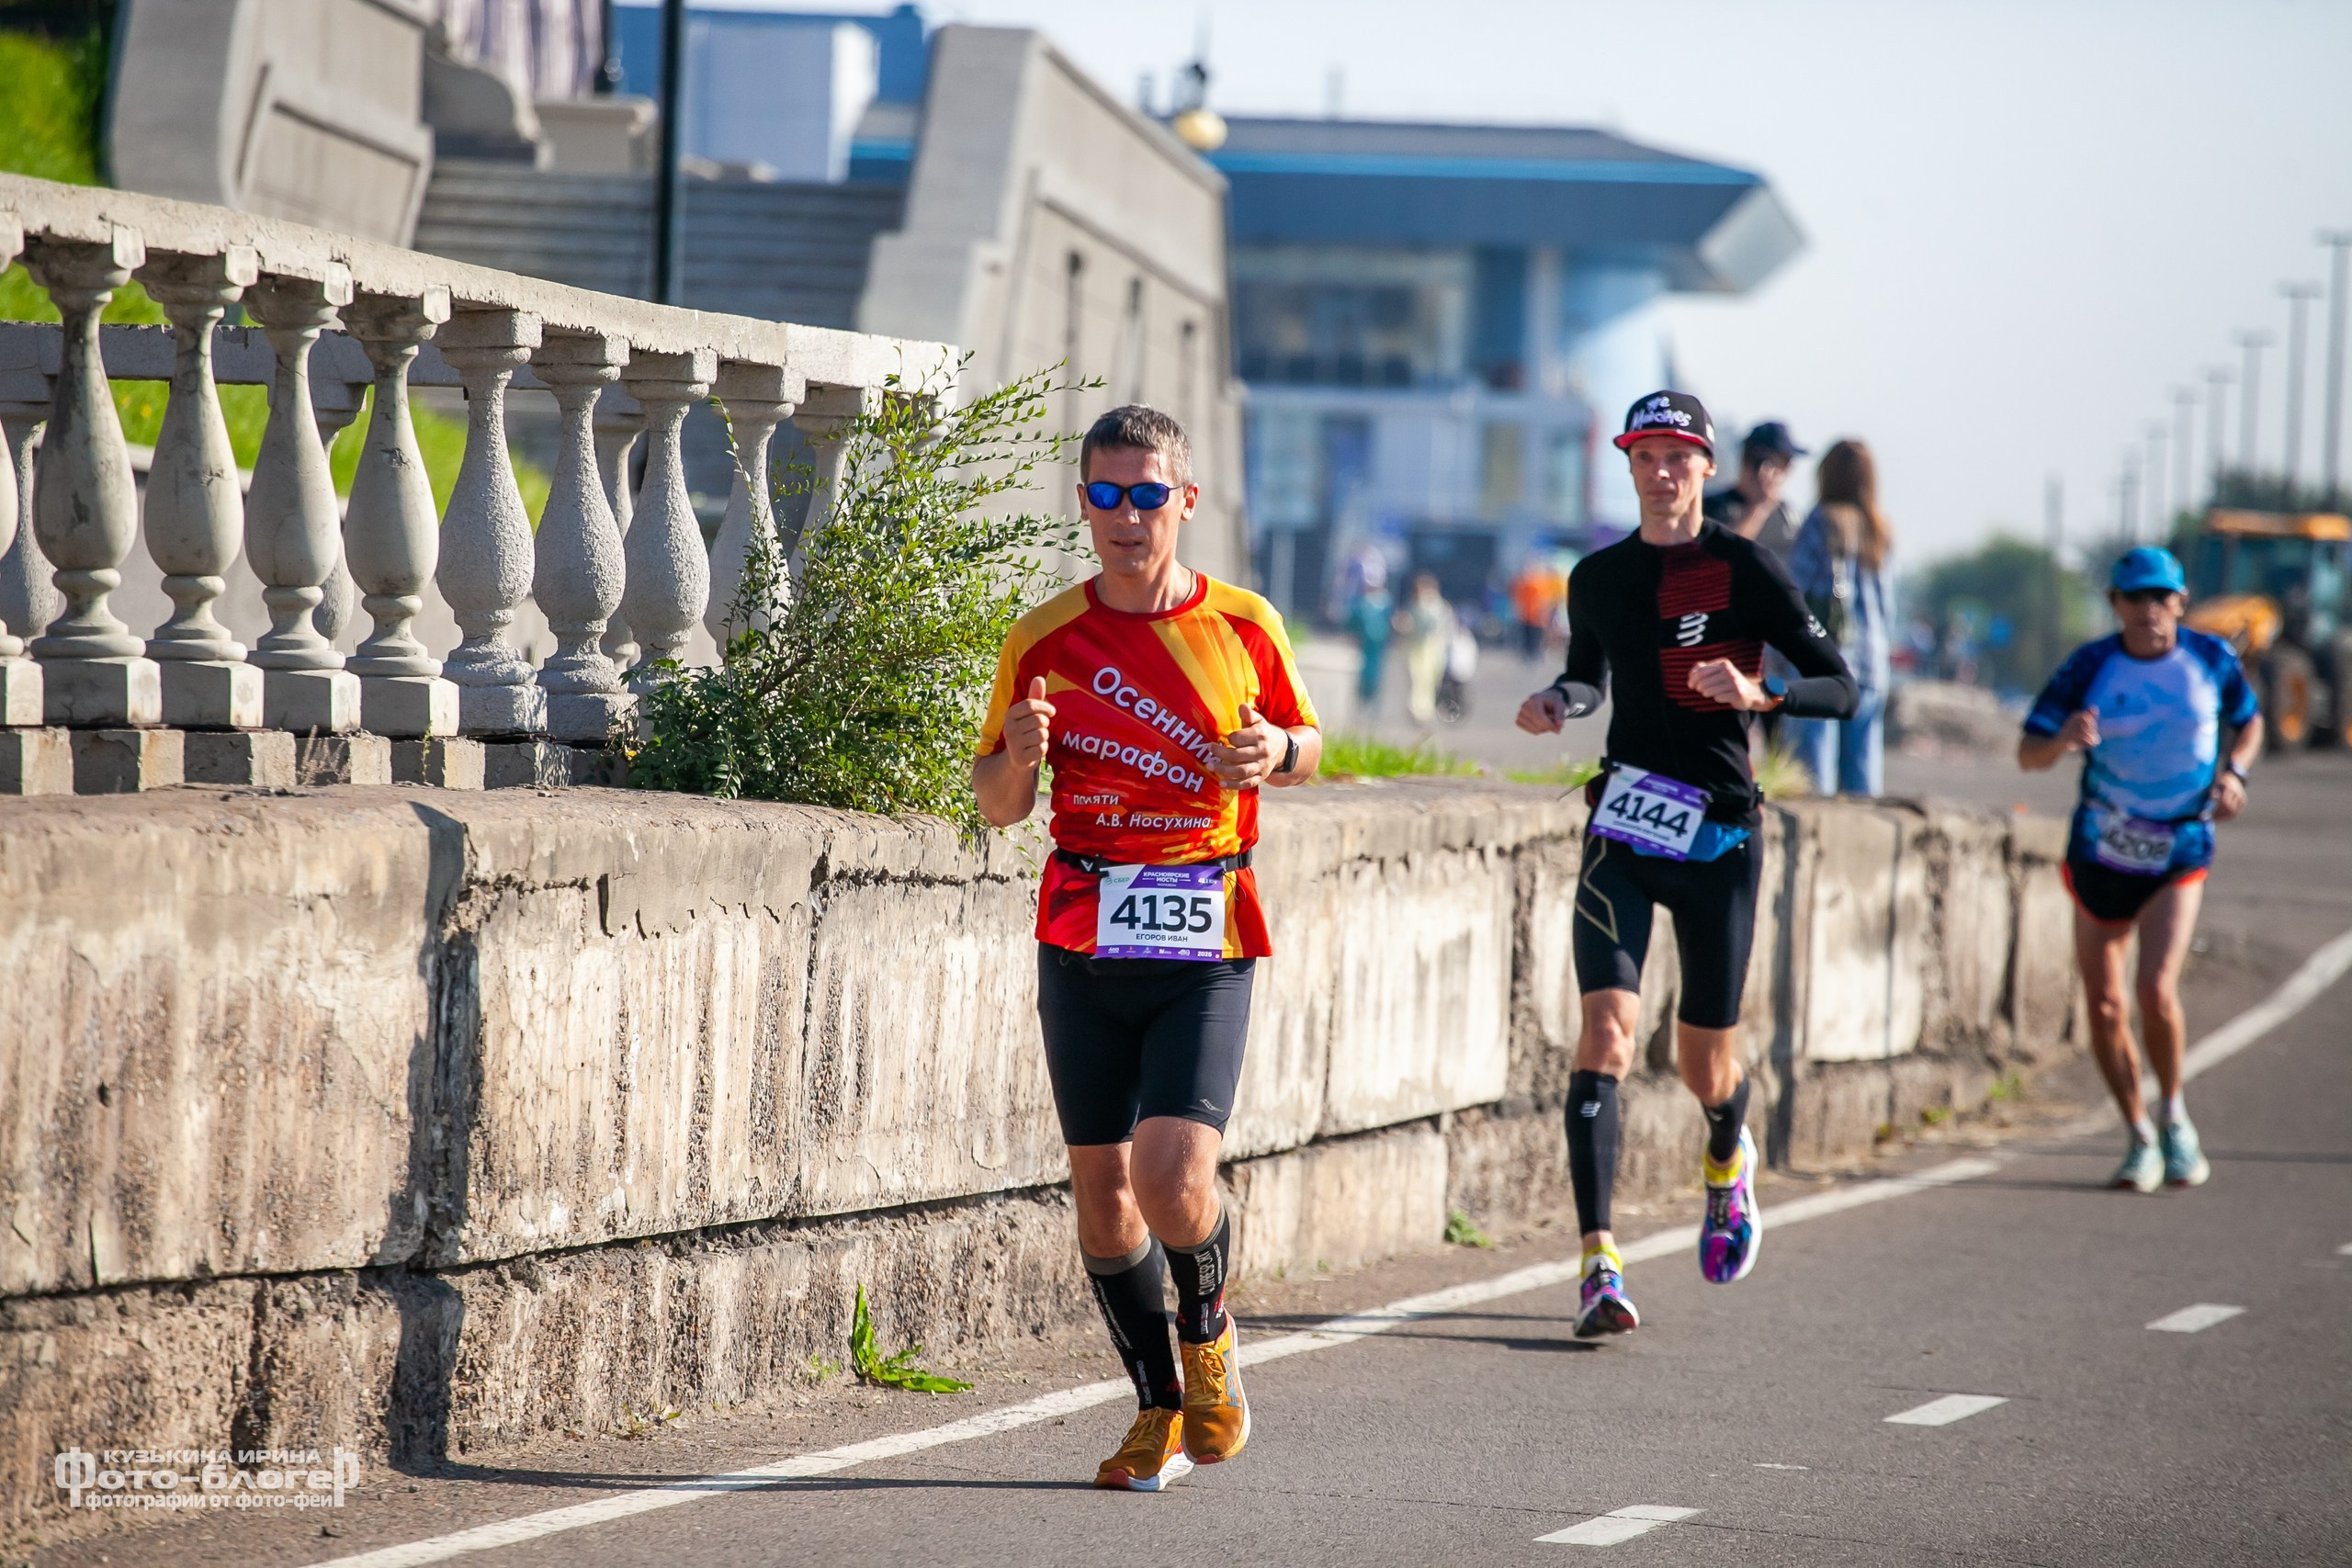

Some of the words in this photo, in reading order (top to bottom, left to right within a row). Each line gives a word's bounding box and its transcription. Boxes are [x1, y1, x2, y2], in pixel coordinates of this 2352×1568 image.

[1062, 730, 1204, 793] марафон
[1096, 813, 1123, 827] А.В.
[1129, 814, 1211, 831] Носухина
[1606, 792, 1690, 838] 4144
[1110, 895, 1213, 933] 4135
